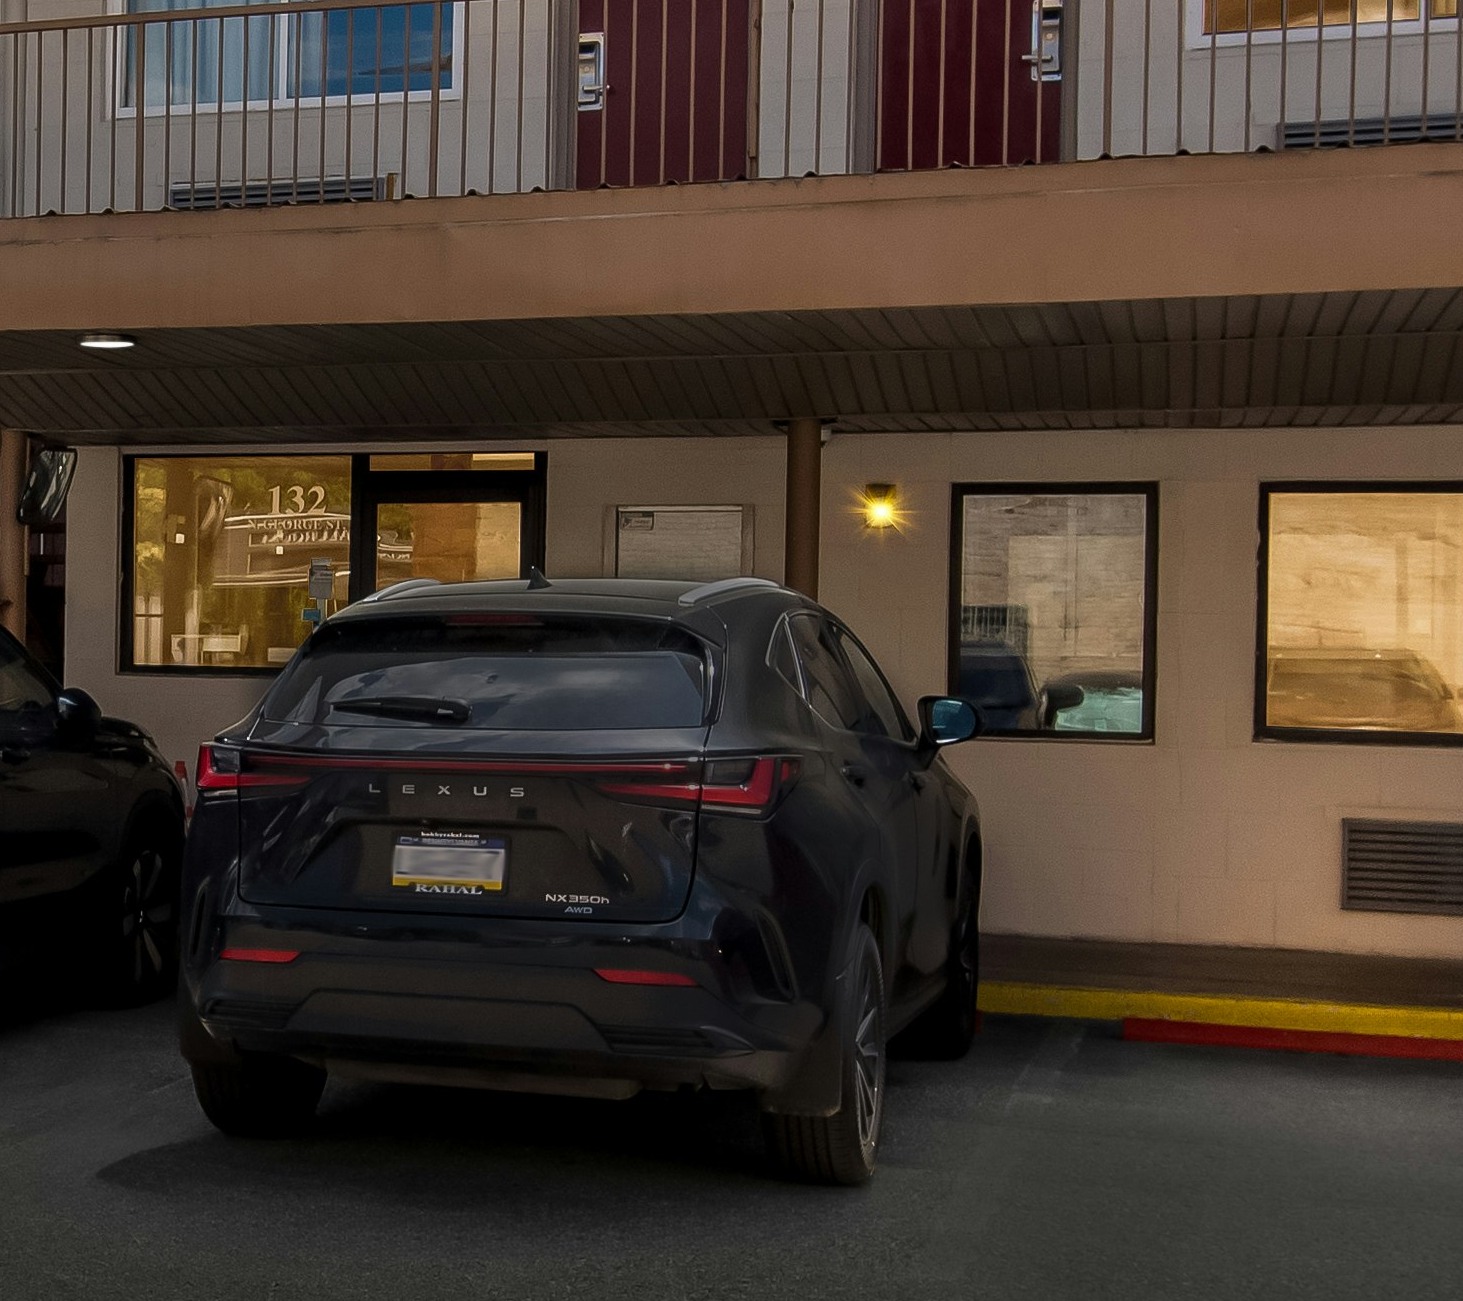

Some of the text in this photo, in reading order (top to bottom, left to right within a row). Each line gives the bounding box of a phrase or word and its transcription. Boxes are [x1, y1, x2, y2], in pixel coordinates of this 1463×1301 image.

[268, 485, 327, 515] 132
[263, 518, 323, 530] GEORGE
[368, 782, 526, 798] LEXUS
[415, 883, 483, 895] RAHAL
[564, 906, 593, 914] AWD
